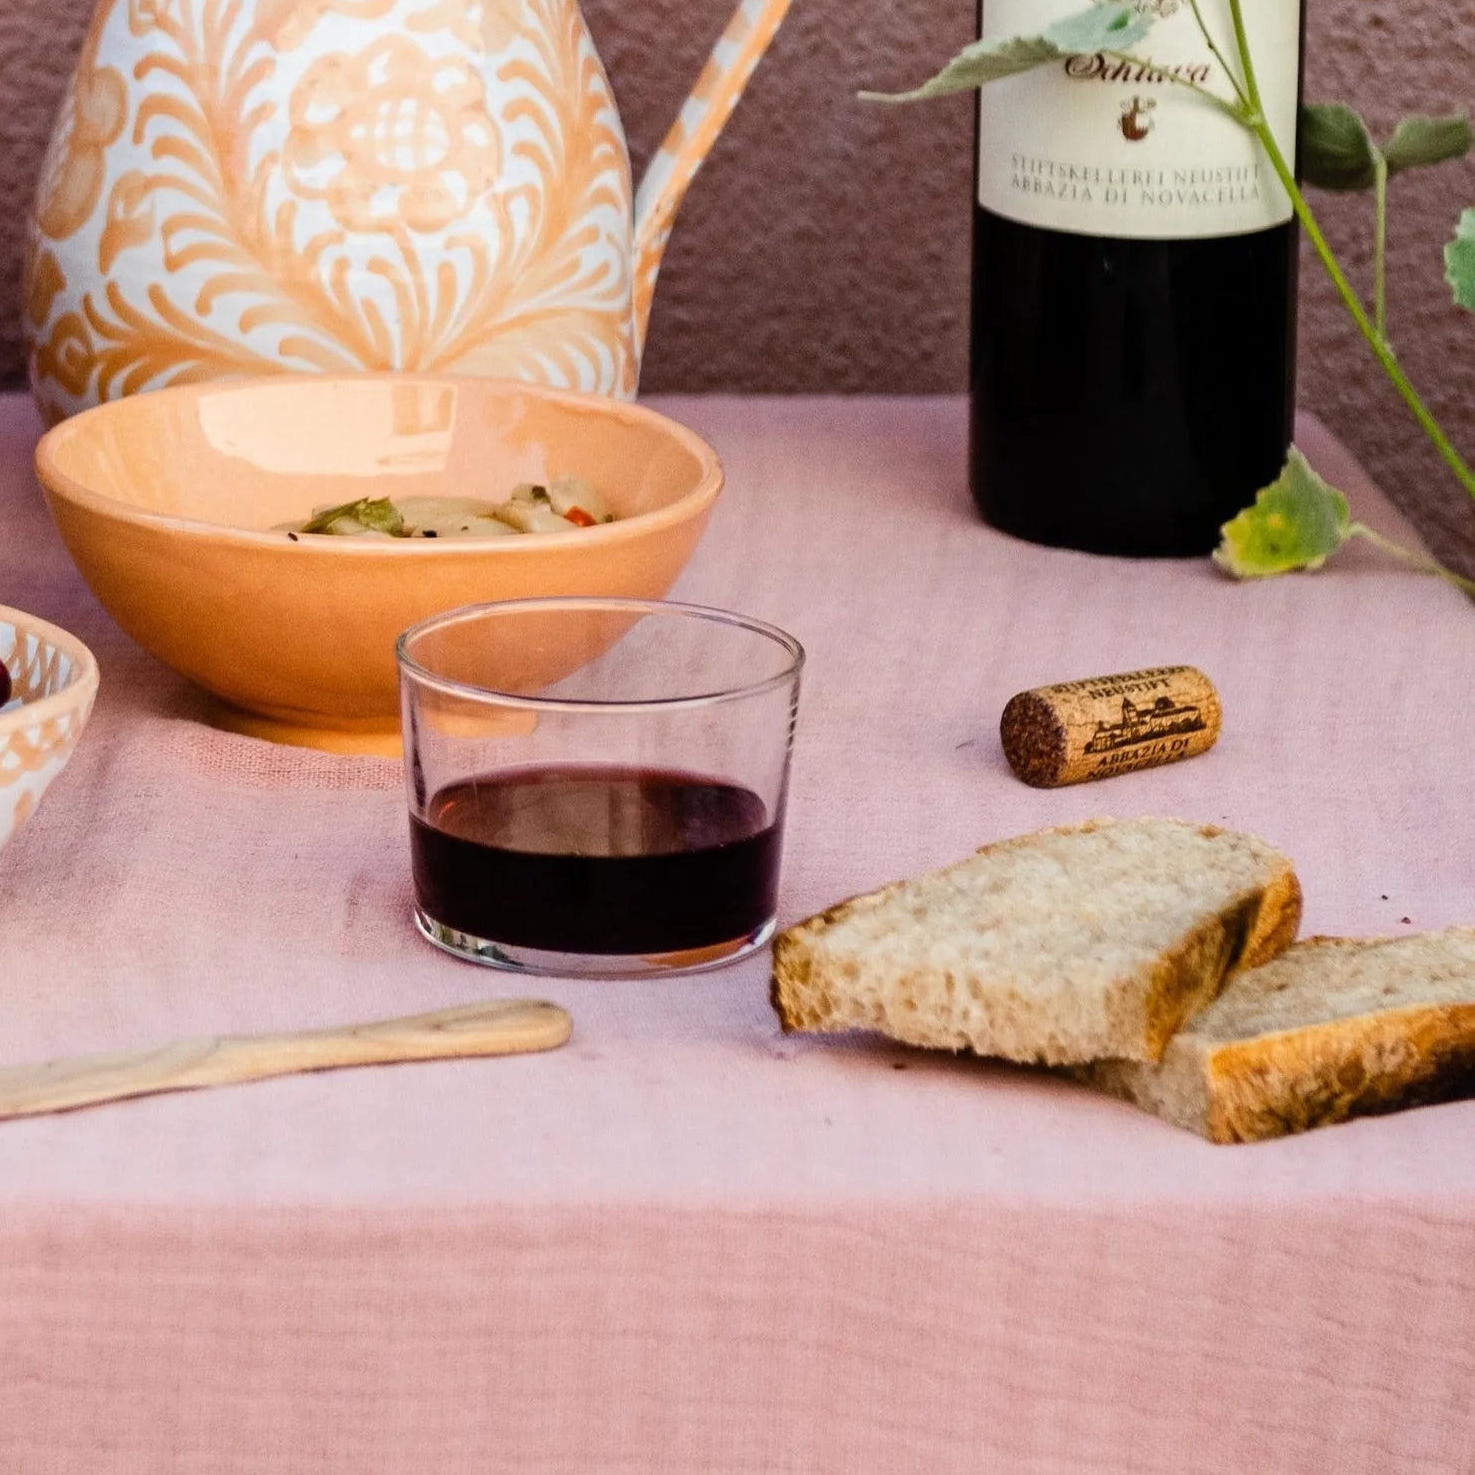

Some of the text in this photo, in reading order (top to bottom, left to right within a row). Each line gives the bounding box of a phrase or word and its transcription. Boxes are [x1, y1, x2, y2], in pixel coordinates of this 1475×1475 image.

[1012, 173, 1259, 206] ABBAZIA DI NOVACELLA
[1088, 676, 1171, 699] NEUSTIFT
[1097, 738, 1190, 768] ABBAZIA DI
